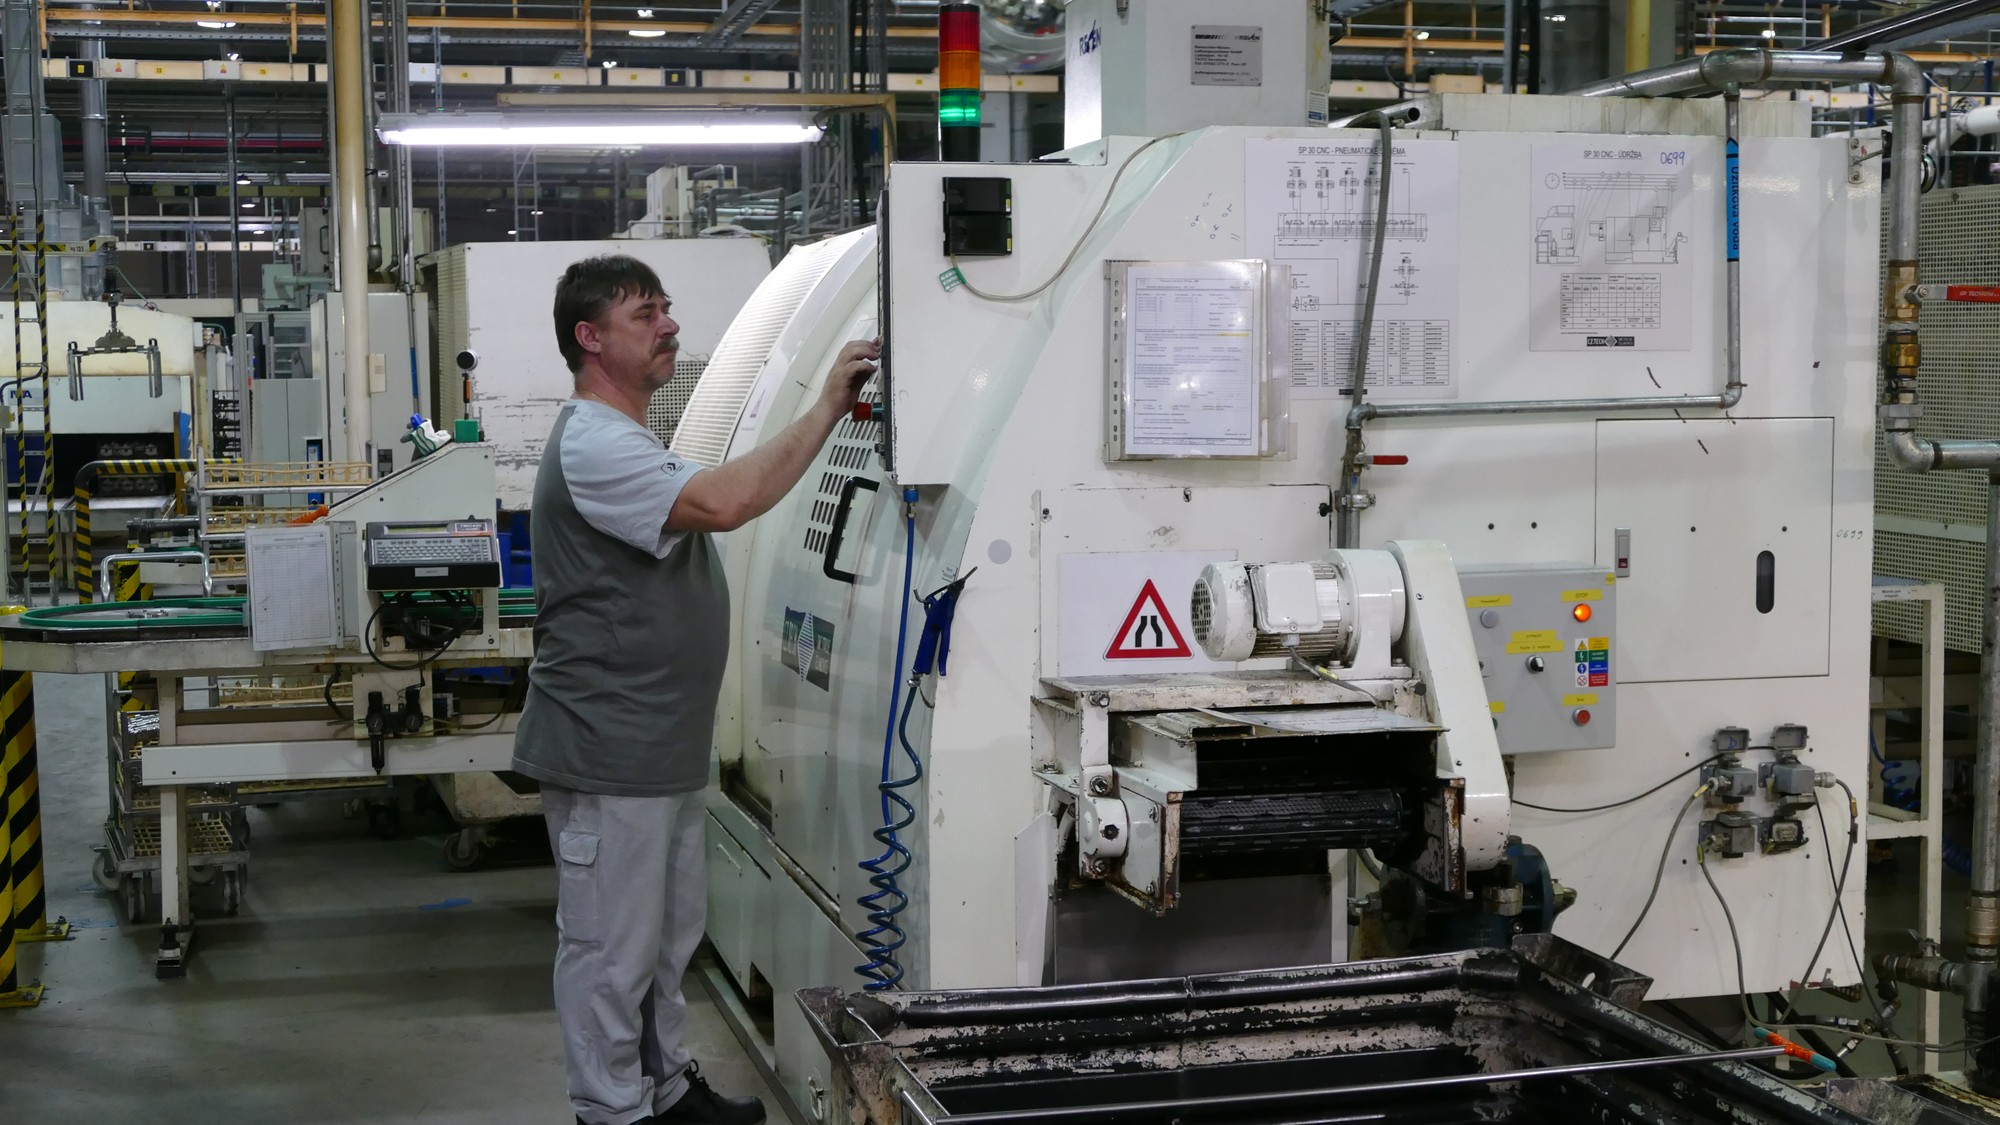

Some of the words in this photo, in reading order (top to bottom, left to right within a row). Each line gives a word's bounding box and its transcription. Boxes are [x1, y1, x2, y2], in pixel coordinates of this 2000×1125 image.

[1298, 146, 1307, 154] SP
[1308, 146, 1316, 154] 30
[1316, 146, 1330, 154] CNC
[1600, 150, 1614, 158] CNC
[1660, 151, 1686, 166] 0699
